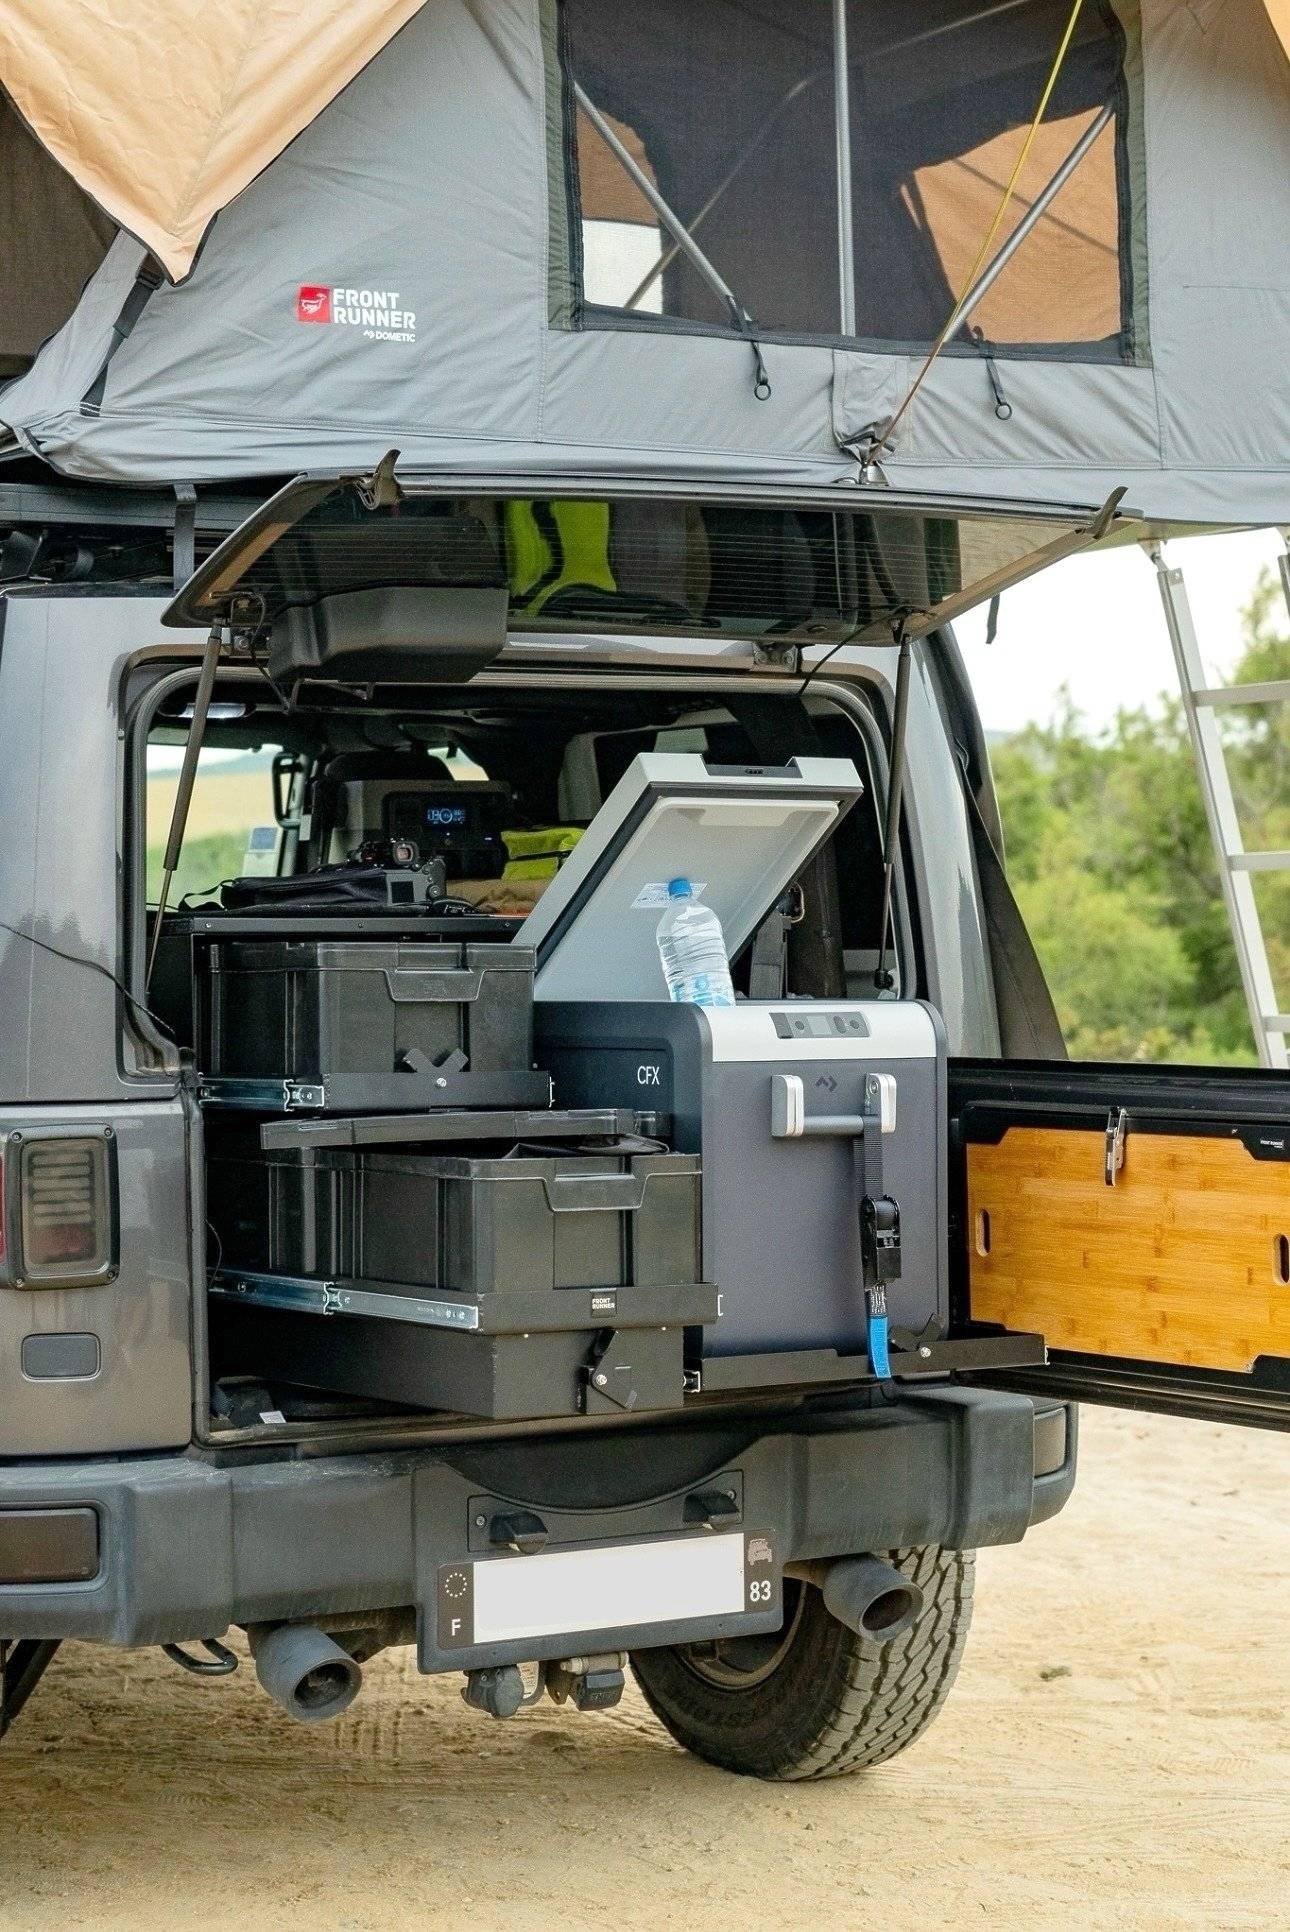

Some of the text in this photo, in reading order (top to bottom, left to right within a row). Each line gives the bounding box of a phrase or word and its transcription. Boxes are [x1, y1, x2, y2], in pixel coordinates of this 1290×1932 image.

[333, 288, 399, 309] FRONT
[333, 306, 416, 329] RUNNER
[375, 331, 416, 343] DOMETIC
[637, 1065, 660, 1085] CFX
[750, 1580, 771, 1602] 83
[451, 1618, 461, 1636] F
